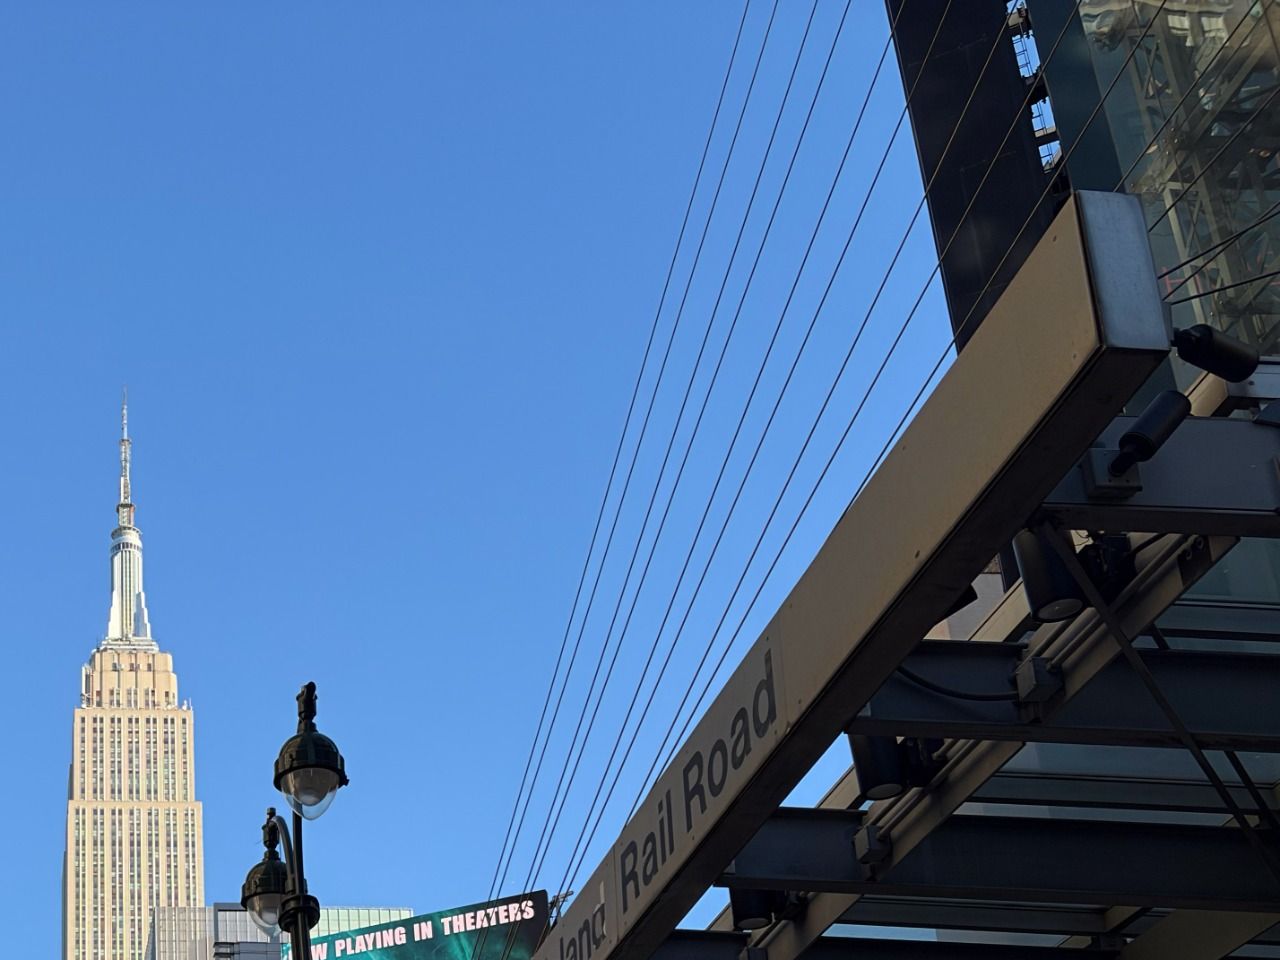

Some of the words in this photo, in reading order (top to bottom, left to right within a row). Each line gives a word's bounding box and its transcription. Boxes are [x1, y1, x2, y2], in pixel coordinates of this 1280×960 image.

[620, 800, 676, 914] Rail
[683, 649, 779, 833] Road
[334, 926, 408, 958] PLAYING
[413, 920, 433, 942] IN
[440, 899, 536, 937] THEATERS
